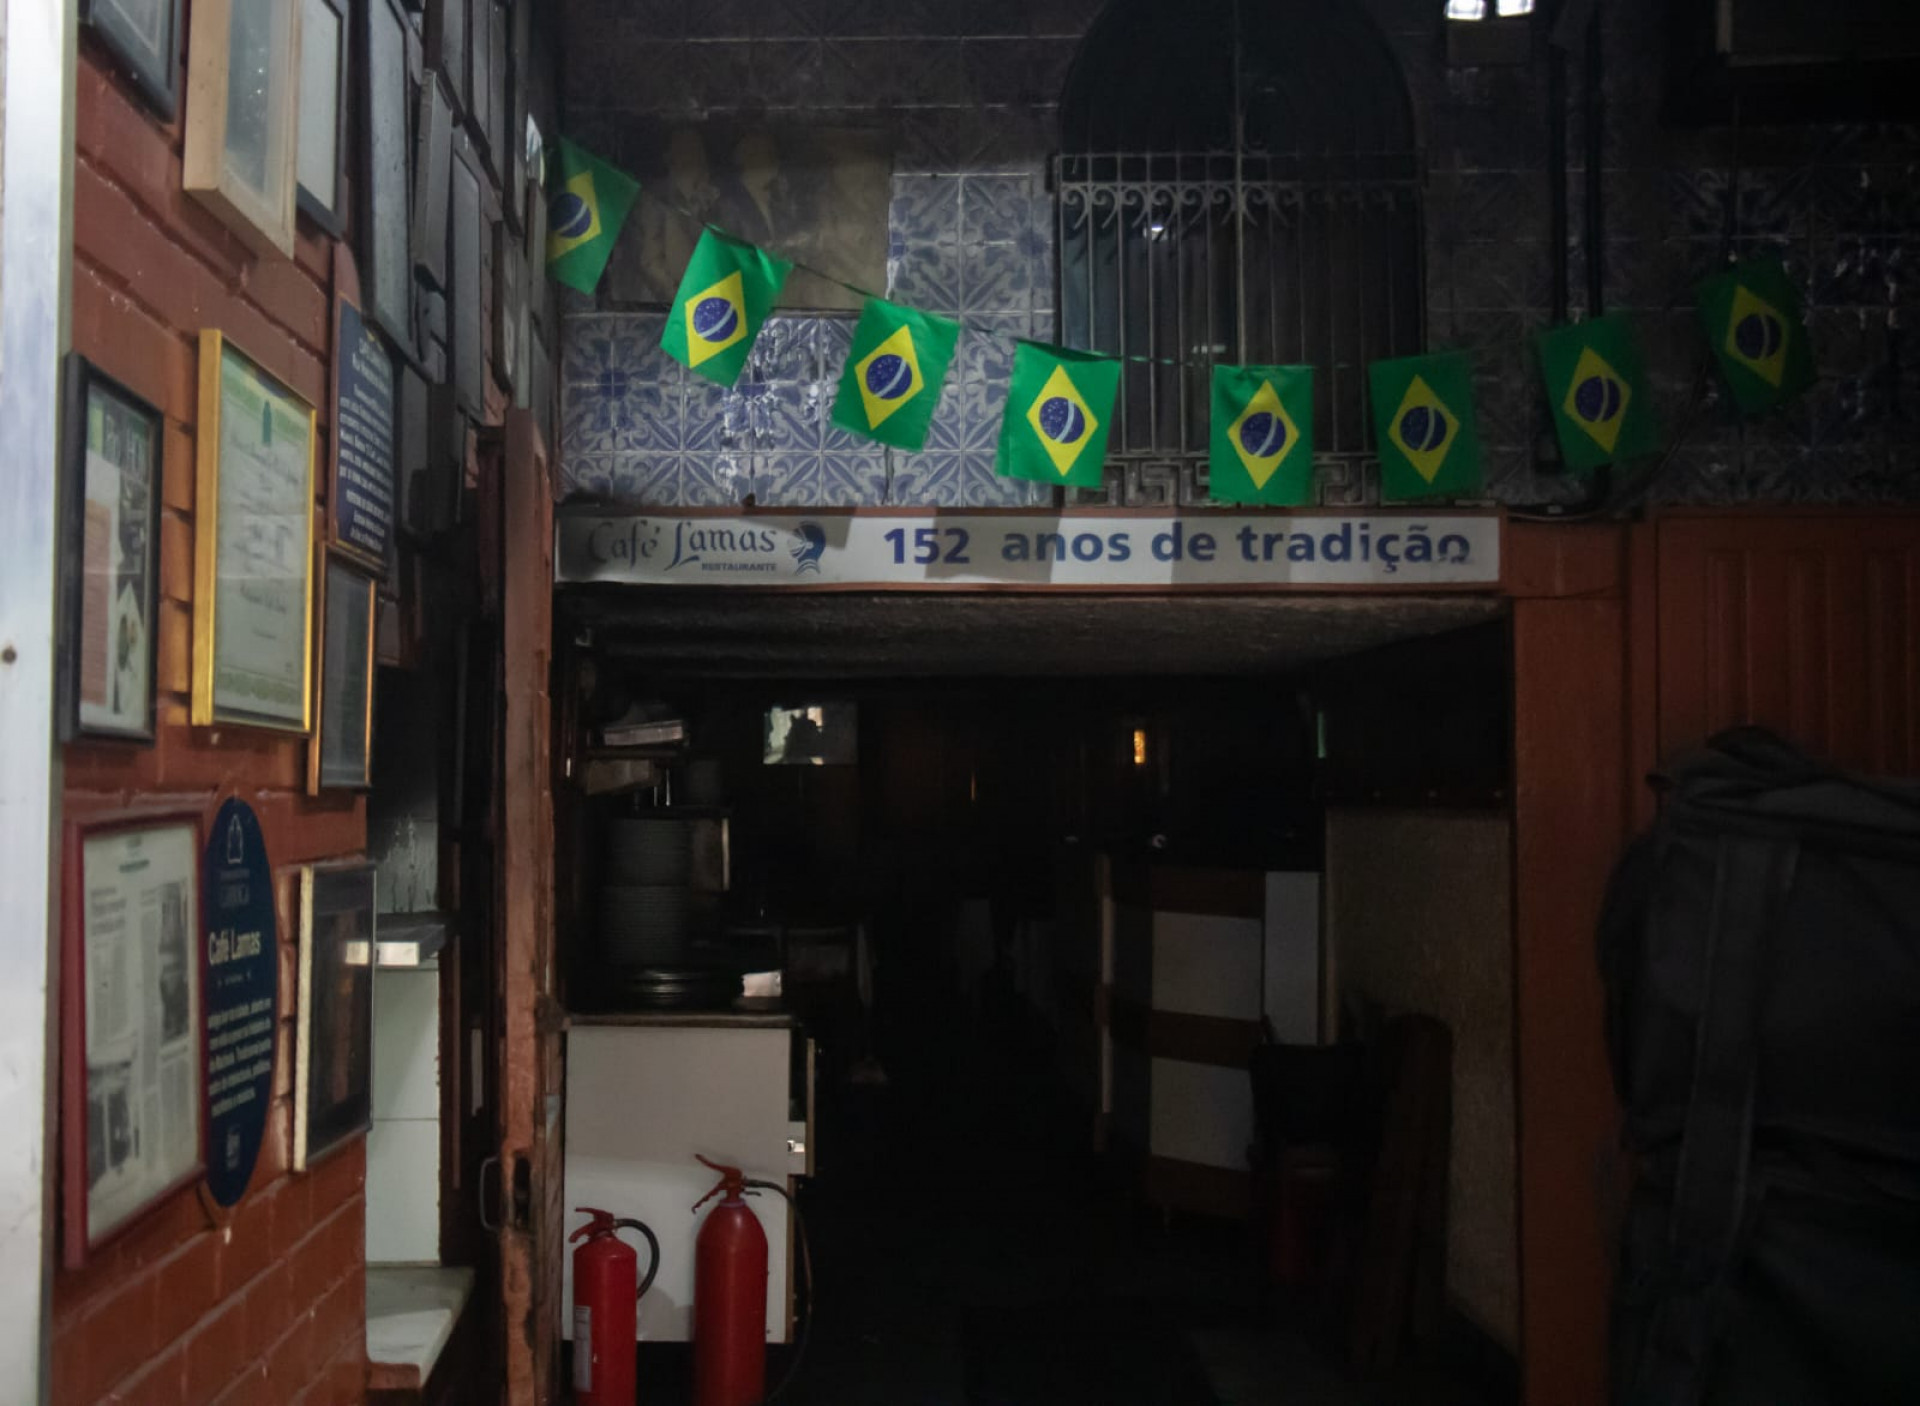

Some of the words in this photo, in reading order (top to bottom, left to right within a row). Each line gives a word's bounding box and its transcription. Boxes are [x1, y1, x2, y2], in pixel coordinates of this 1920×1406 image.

[588, 520, 660, 570] Café
[665, 520, 777, 571] Lamas
[701, 563, 776, 572] RESTAURANTE
[884, 527, 970, 564] 152
[1002, 531, 1131, 562] anos
[1151, 521, 1216, 562] de
[1236, 522, 1471, 572] tradição
[209, 929, 229, 965] Café
[231, 927, 261, 960] Lamas
